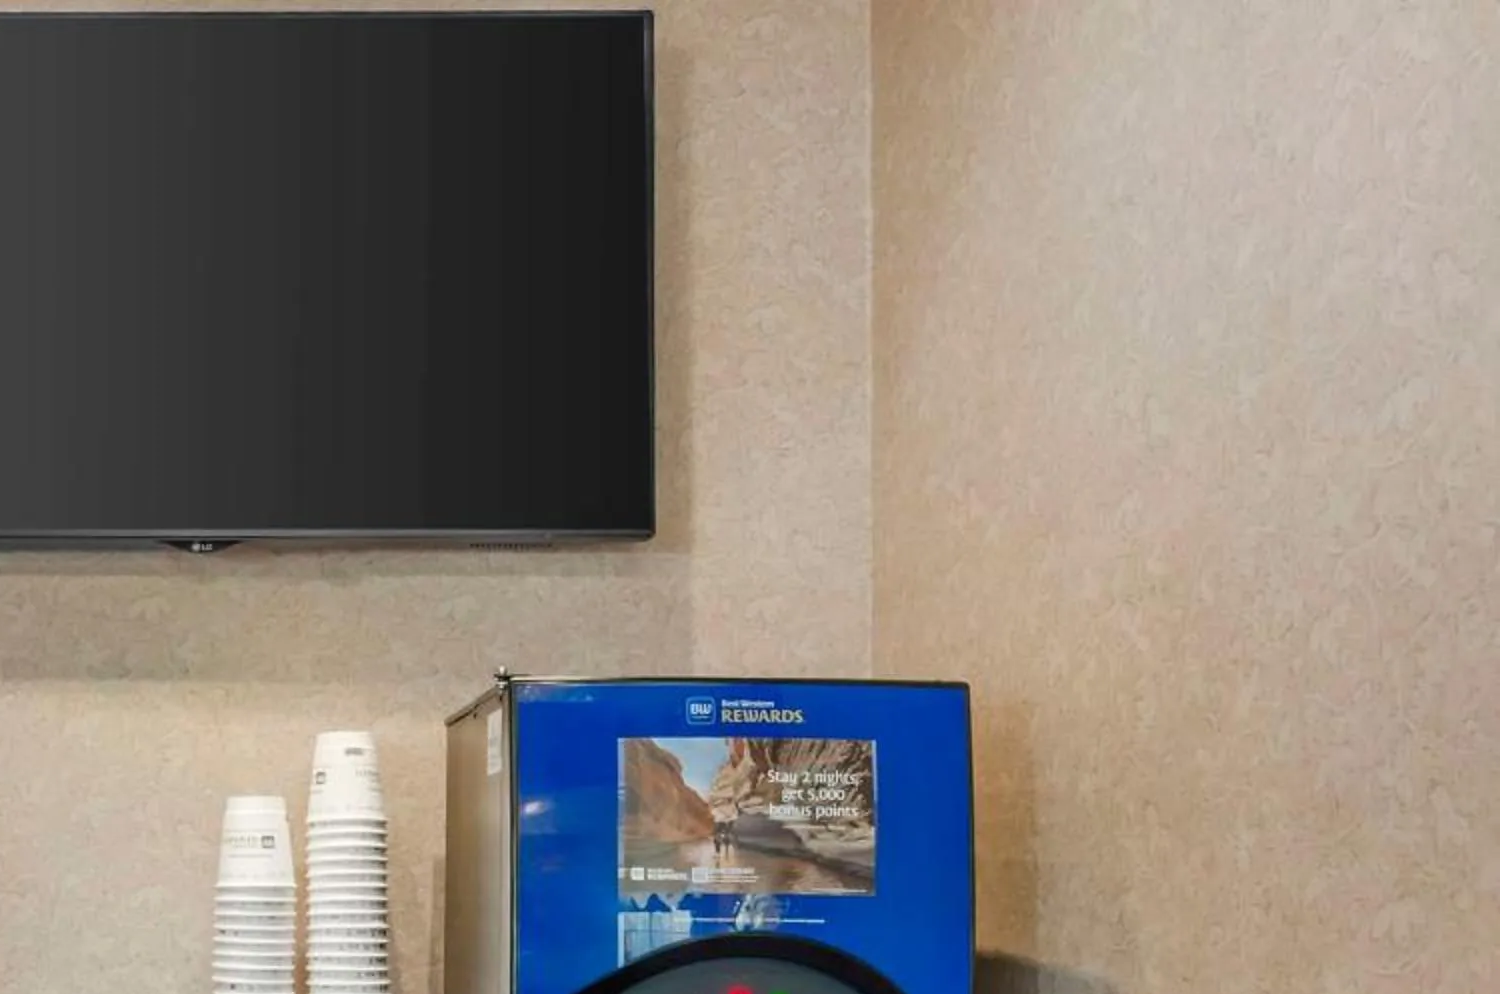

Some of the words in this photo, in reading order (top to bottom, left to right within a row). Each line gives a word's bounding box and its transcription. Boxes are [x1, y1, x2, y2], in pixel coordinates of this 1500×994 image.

[721, 709, 804, 723] REWARDS
[767, 769, 797, 786] Stay
[801, 771, 811, 784] 2
[815, 802, 858, 820] points
